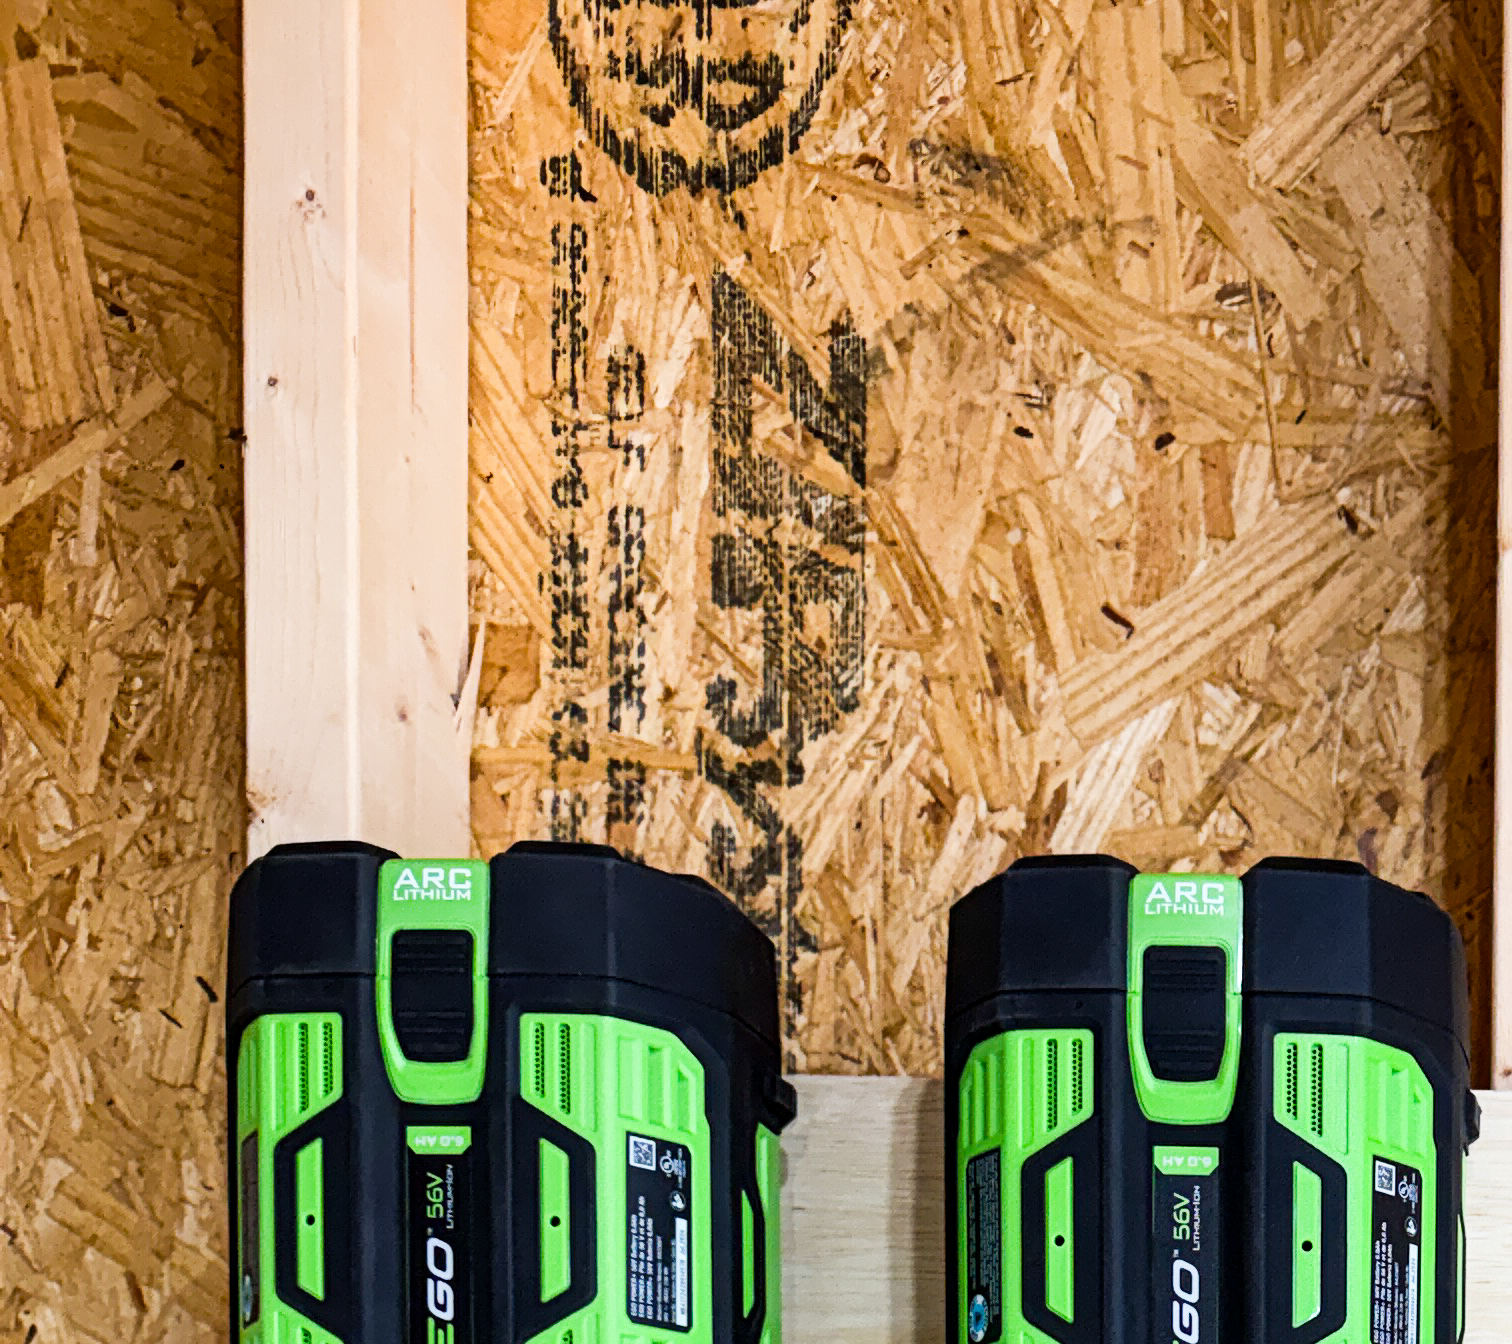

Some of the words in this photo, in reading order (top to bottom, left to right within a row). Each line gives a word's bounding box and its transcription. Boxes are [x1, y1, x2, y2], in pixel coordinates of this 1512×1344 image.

[394, 868, 472, 889] ARC
[393, 889, 471, 901] LITHIUM
[1146, 882, 1224, 904] ARC
[1145, 903, 1224, 916] LITHIUM
[426, 1172, 444, 1219] 56V
[1173, 1192, 1190, 1240] 56V
